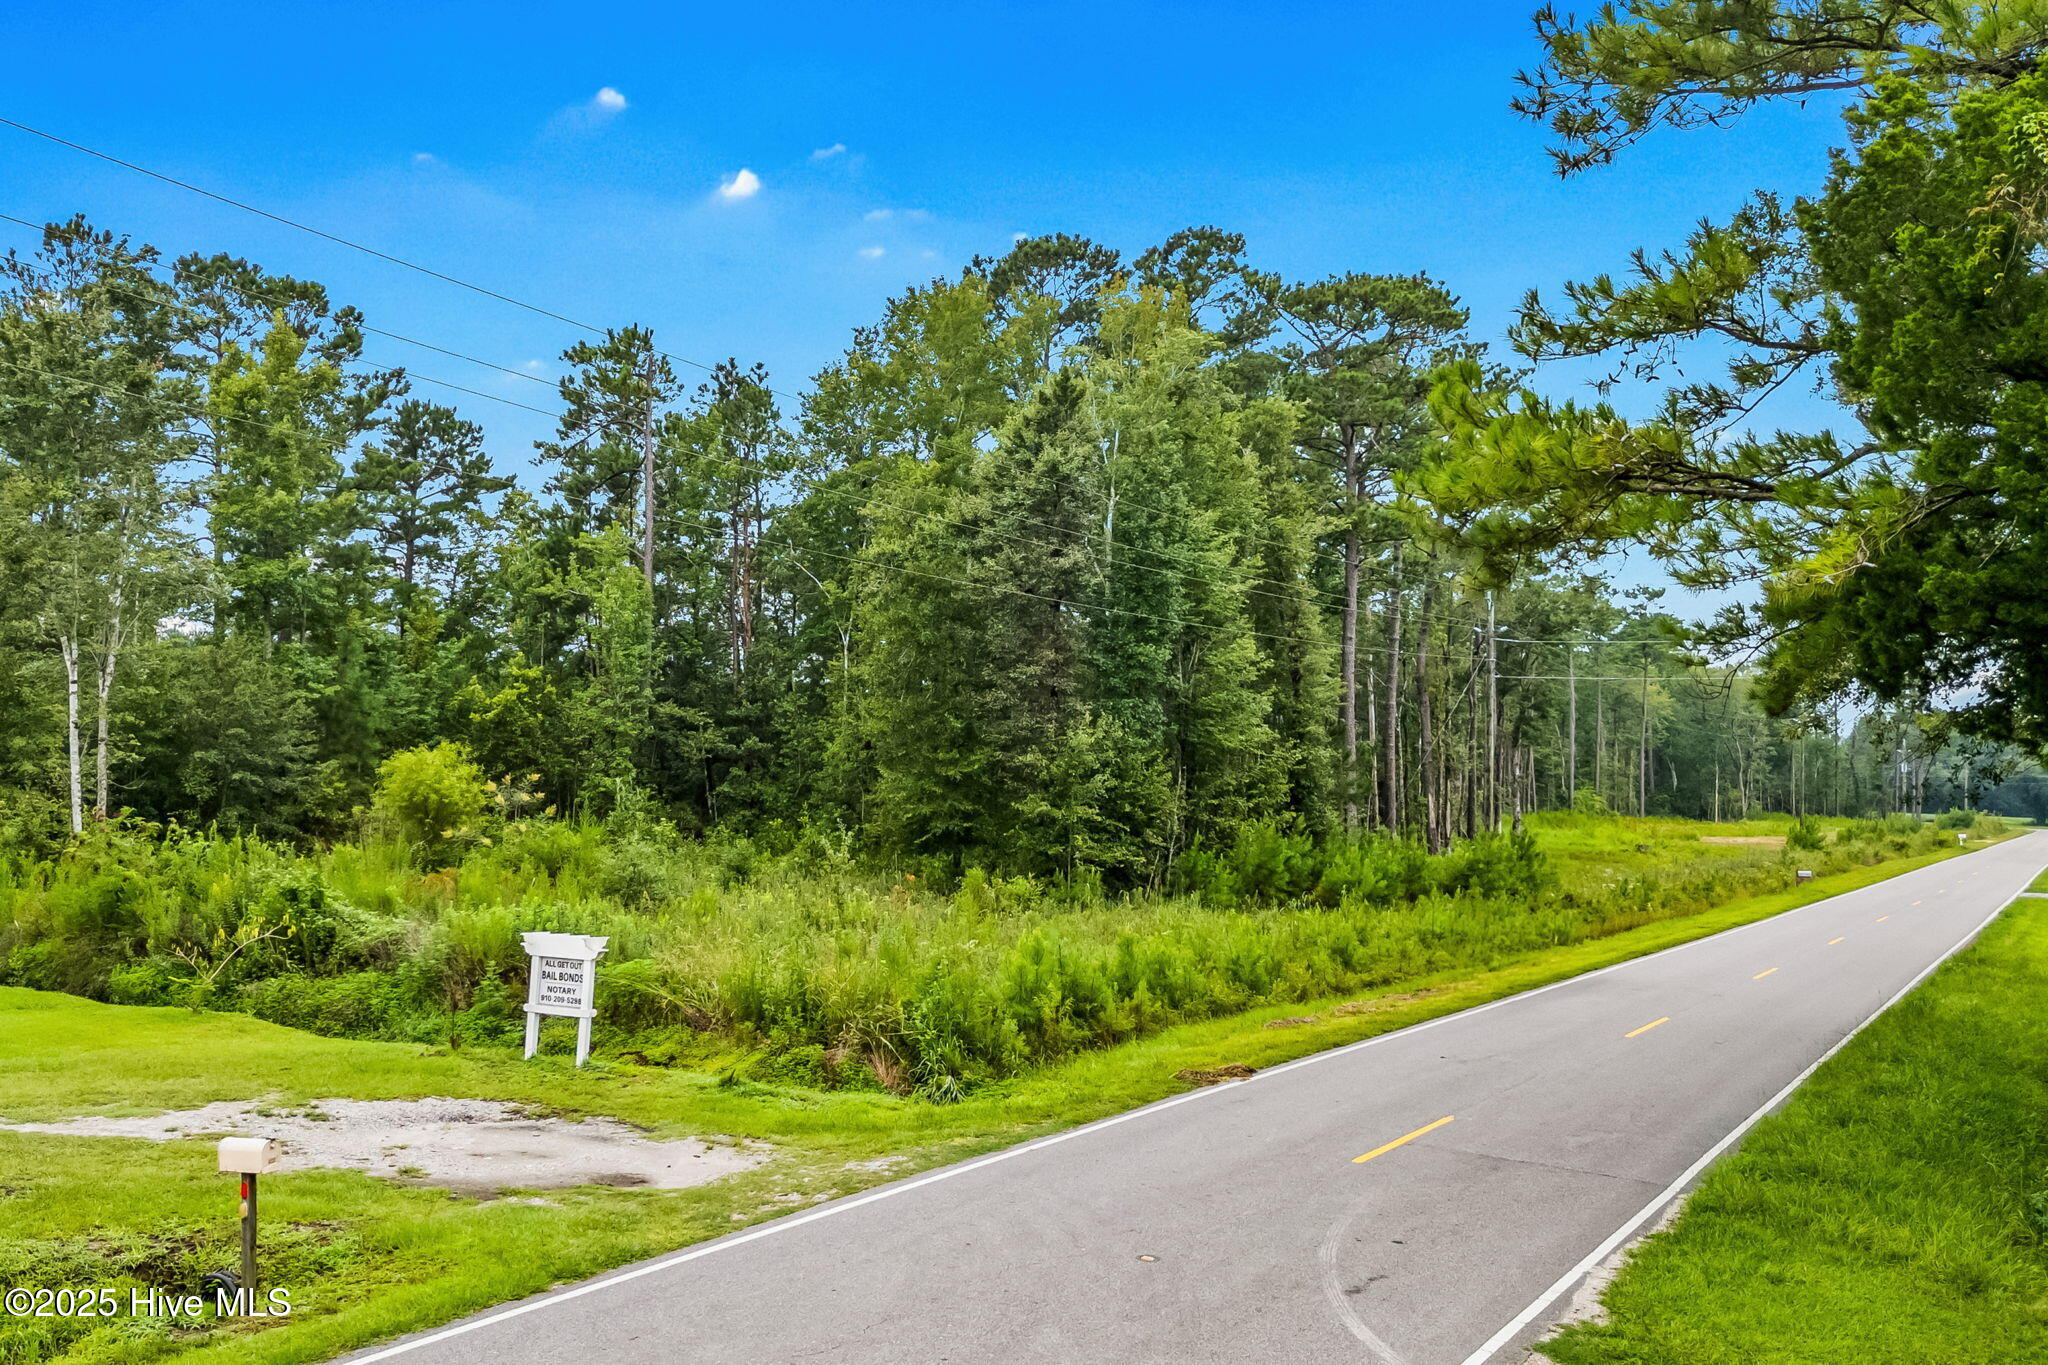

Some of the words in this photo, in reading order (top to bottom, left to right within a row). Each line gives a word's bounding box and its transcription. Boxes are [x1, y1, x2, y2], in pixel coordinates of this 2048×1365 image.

[545, 960, 556, 968] ALL
[557, 961, 569, 969] GET
[570, 962, 583, 970] OUT
[542, 970, 557, 981] BAIL
[559, 972, 584, 984] BONDS
[547, 986, 576, 995] NOTARY
